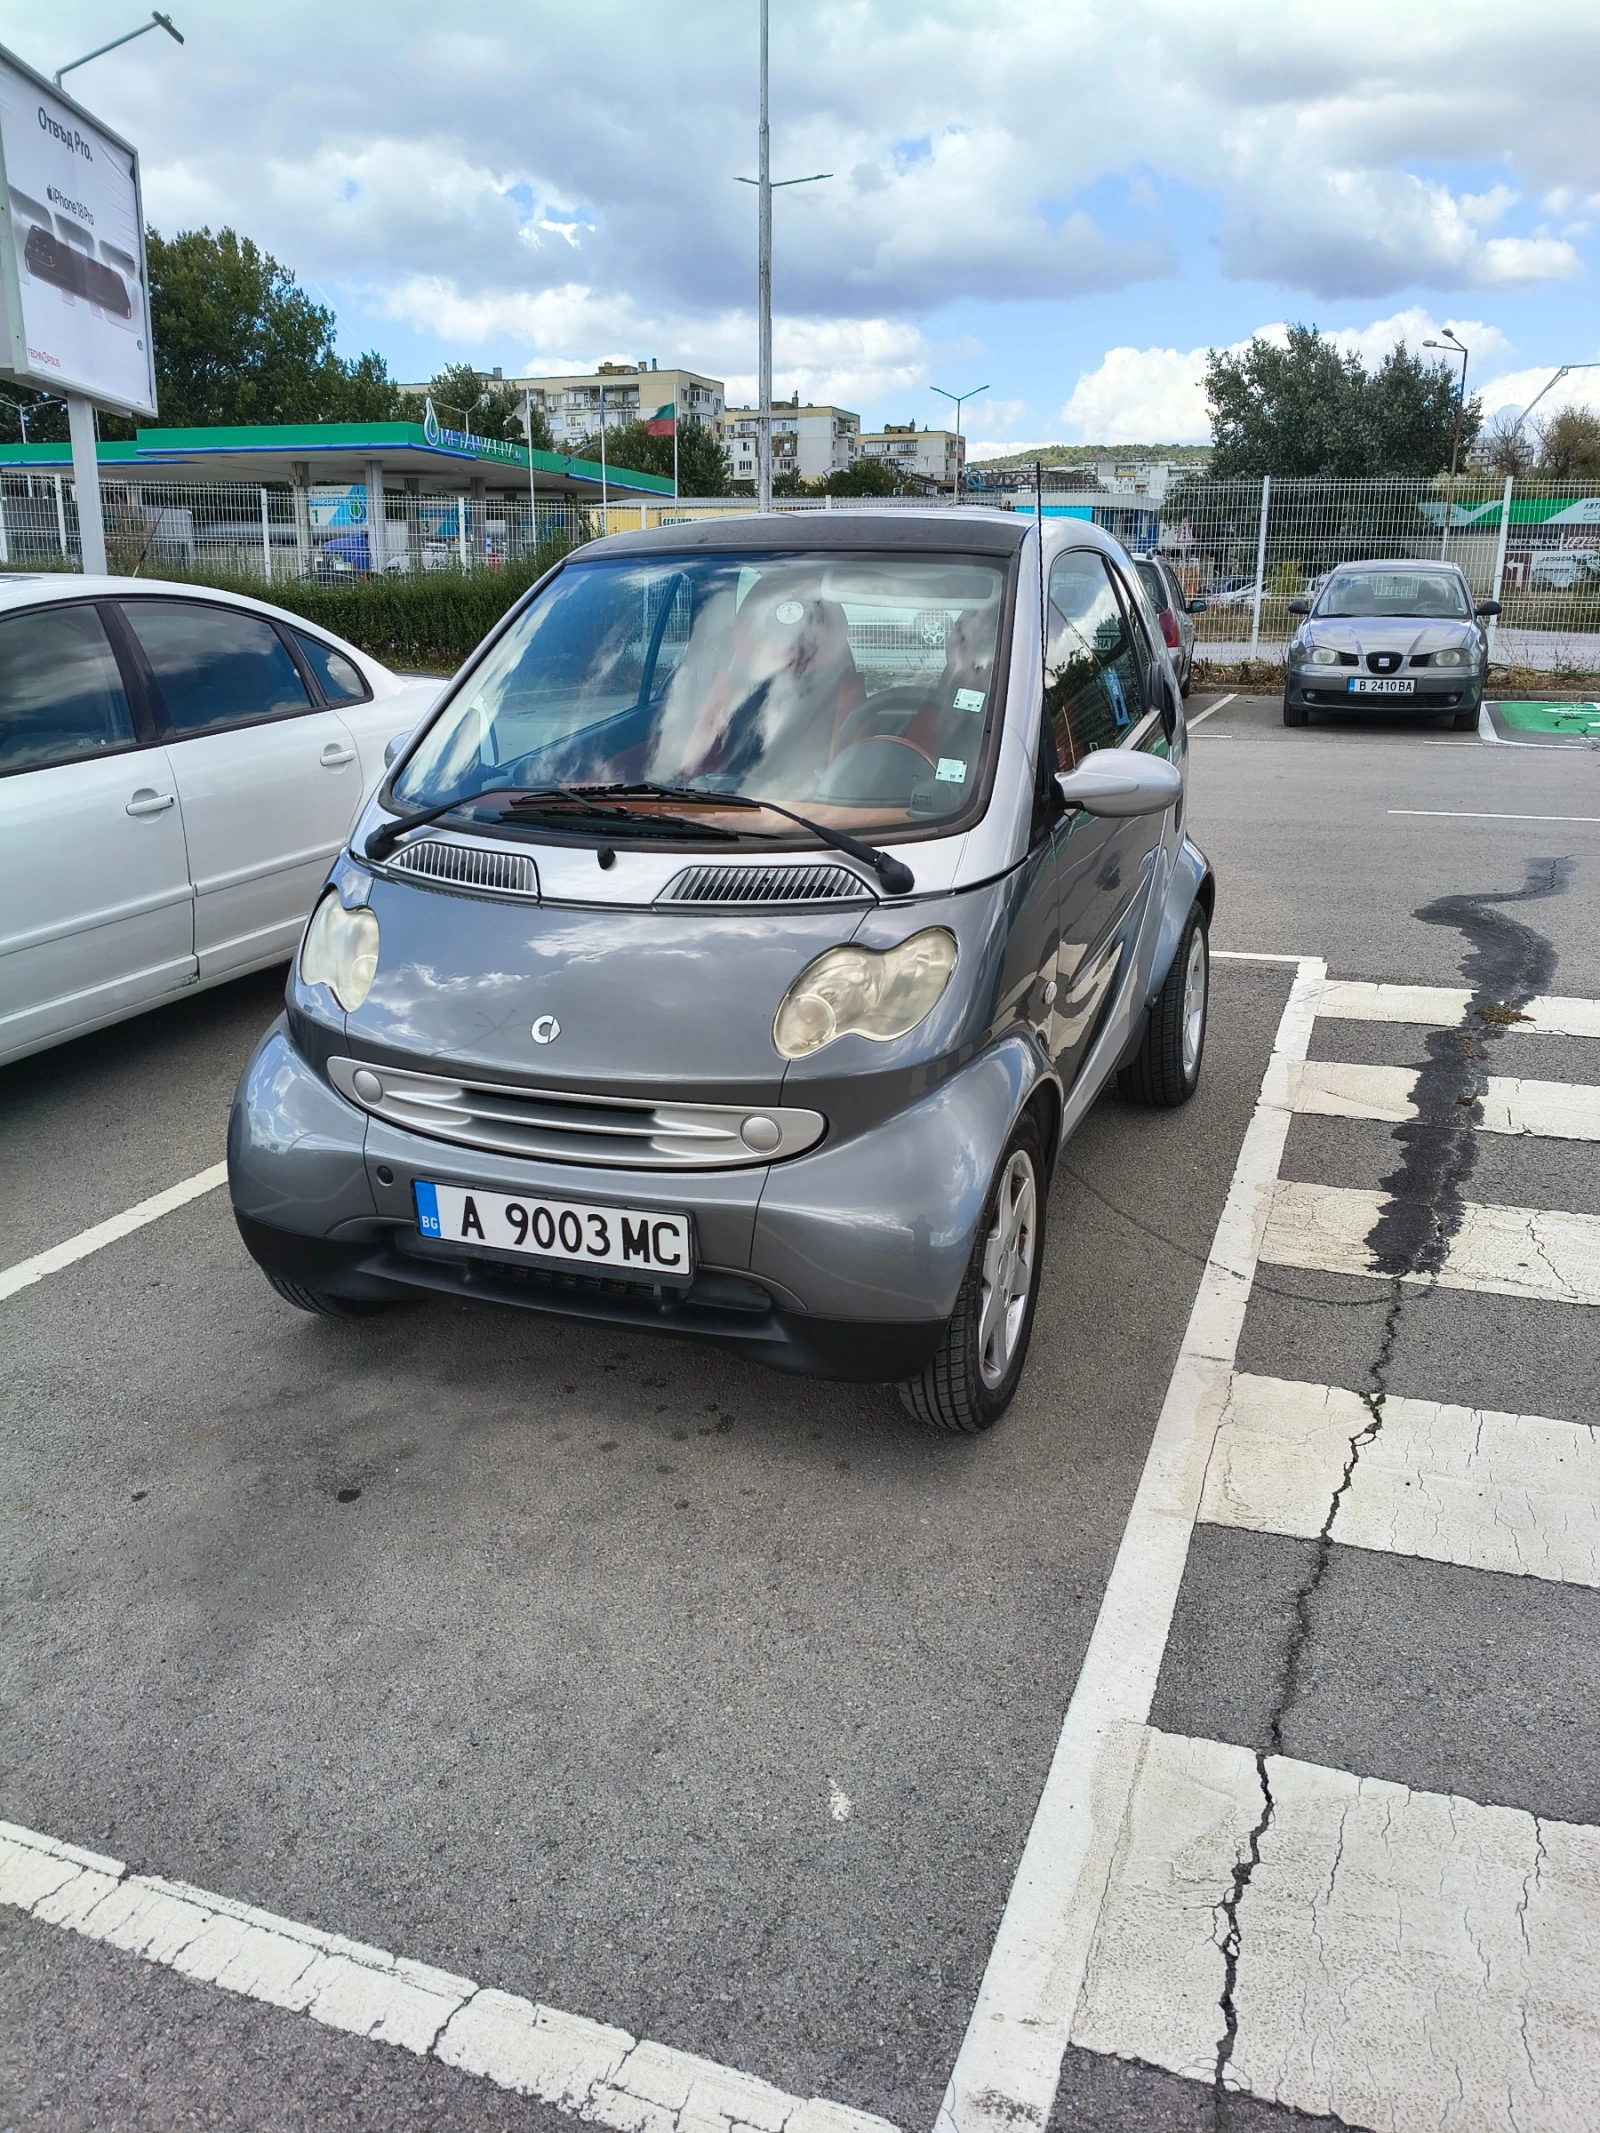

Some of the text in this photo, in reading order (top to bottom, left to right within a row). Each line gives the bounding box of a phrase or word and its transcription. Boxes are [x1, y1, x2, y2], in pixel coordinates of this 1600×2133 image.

[38, 106, 93, 162] Отвъд Pro.
[52, 187, 77, 215] iPhone
[84, 206, 95, 226] Pro
[312, 509, 318, 523] 1
[1360, 681, 1412, 691] B 2410 BA
[422, 1215, 438, 1230] BG
[461, 1196, 680, 1266] A 9003 MC
